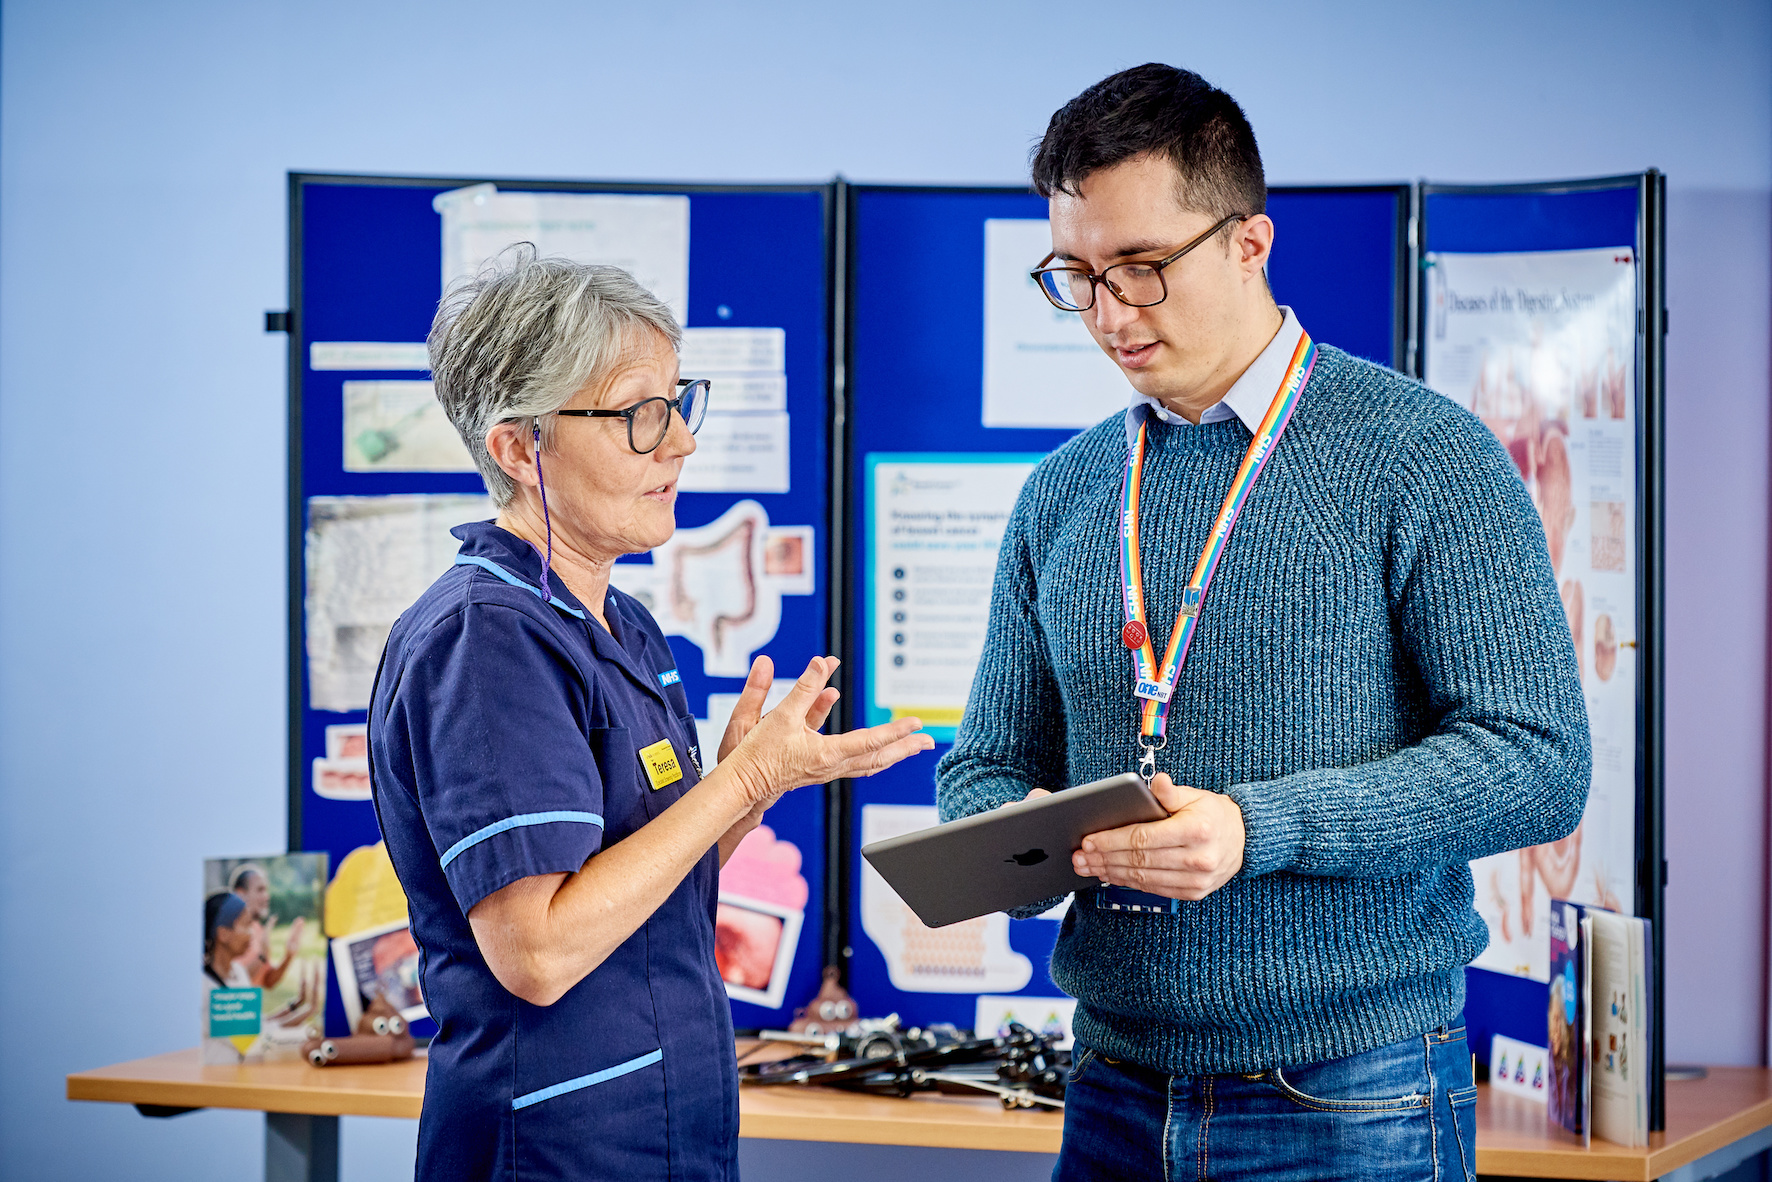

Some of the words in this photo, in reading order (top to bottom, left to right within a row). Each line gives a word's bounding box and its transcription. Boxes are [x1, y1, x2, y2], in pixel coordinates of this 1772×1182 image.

[1517, 287, 1558, 317] Digestiv
[1286, 363, 1306, 394] NHS
[1129, 441, 1141, 467] NHS
[1250, 432, 1272, 464] NHS
[1123, 510, 1134, 538] NHS
[1215, 506, 1235, 539] NHS
[1126, 585, 1140, 615] NHS
[661, 671, 679, 685] NHS
[1139, 662, 1152, 680] NH
[1161, 662, 1176, 685] HS
[1138, 682, 1158, 696] one
[652, 758, 676, 776] Teresa
